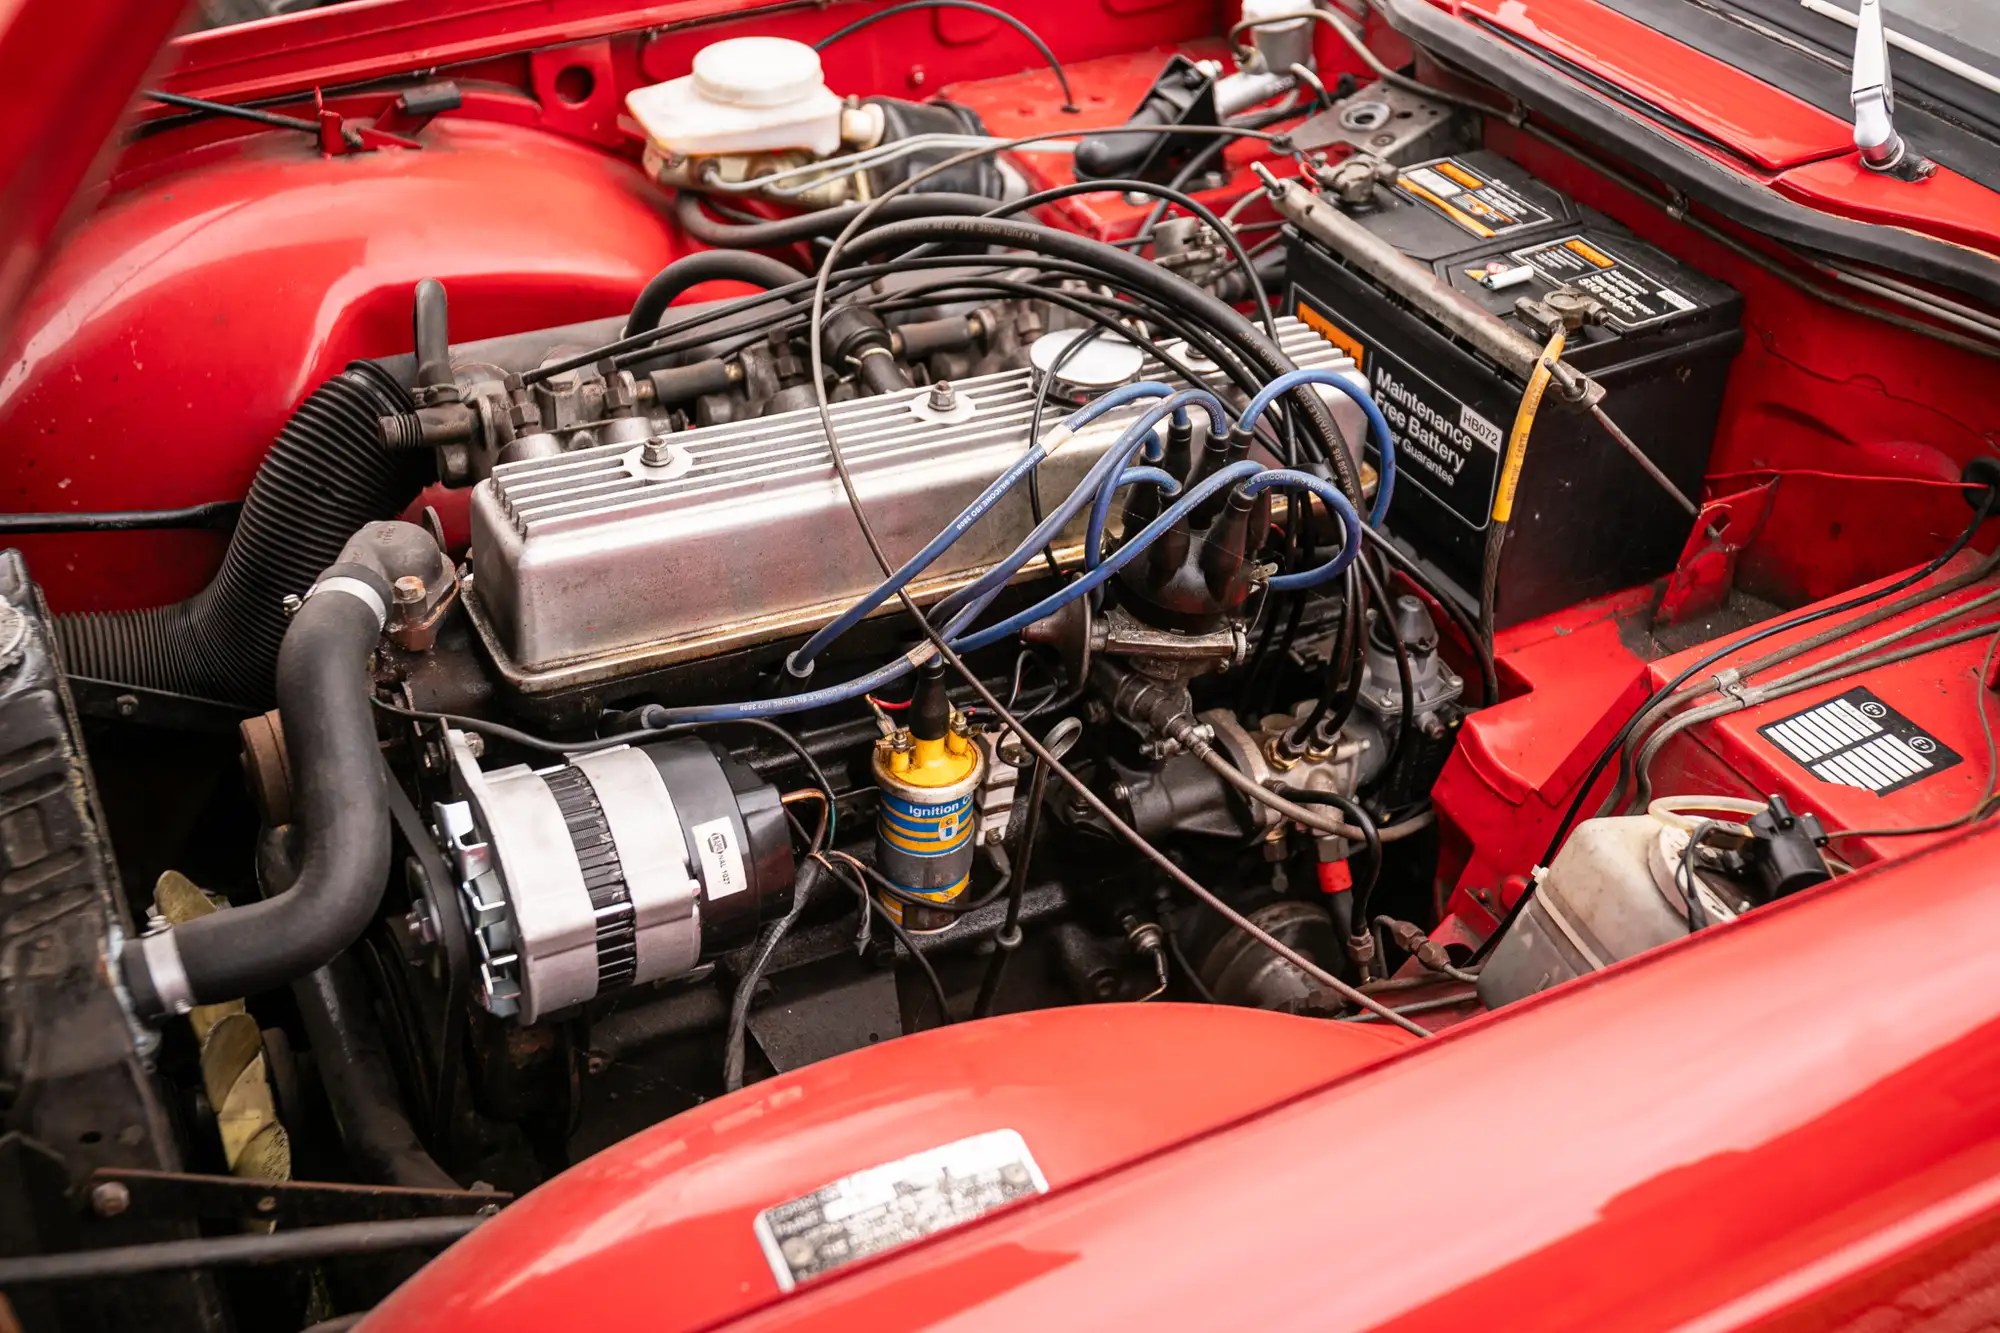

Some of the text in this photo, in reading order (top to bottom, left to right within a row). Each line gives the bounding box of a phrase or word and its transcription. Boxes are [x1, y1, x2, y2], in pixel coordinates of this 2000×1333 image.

[1295, 386, 1312, 406] FOR
[1376, 367, 1473, 452] Maintenance
[1308, 404, 1337, 446] SUITABLE
[1374, 390, 1465, 473] Free Battery
[1463, 411, 1498, 446] HB072
[1331, 446, 1343, 460] R6
[1402, 438, 1455, 486] Guarantee
[1337, 460, 1349, 476] J30
[955, 456, 1036, 531] DOUBLE SILICONE ISO 3808
[1342, 475, 1355, 495] SAE
[738, 702, 756, 712] 3808
[757, 700, 771, 709] ISO
[771, 694, 807, 708] SILICONE
[909, 802, 959, 818] Ignition
